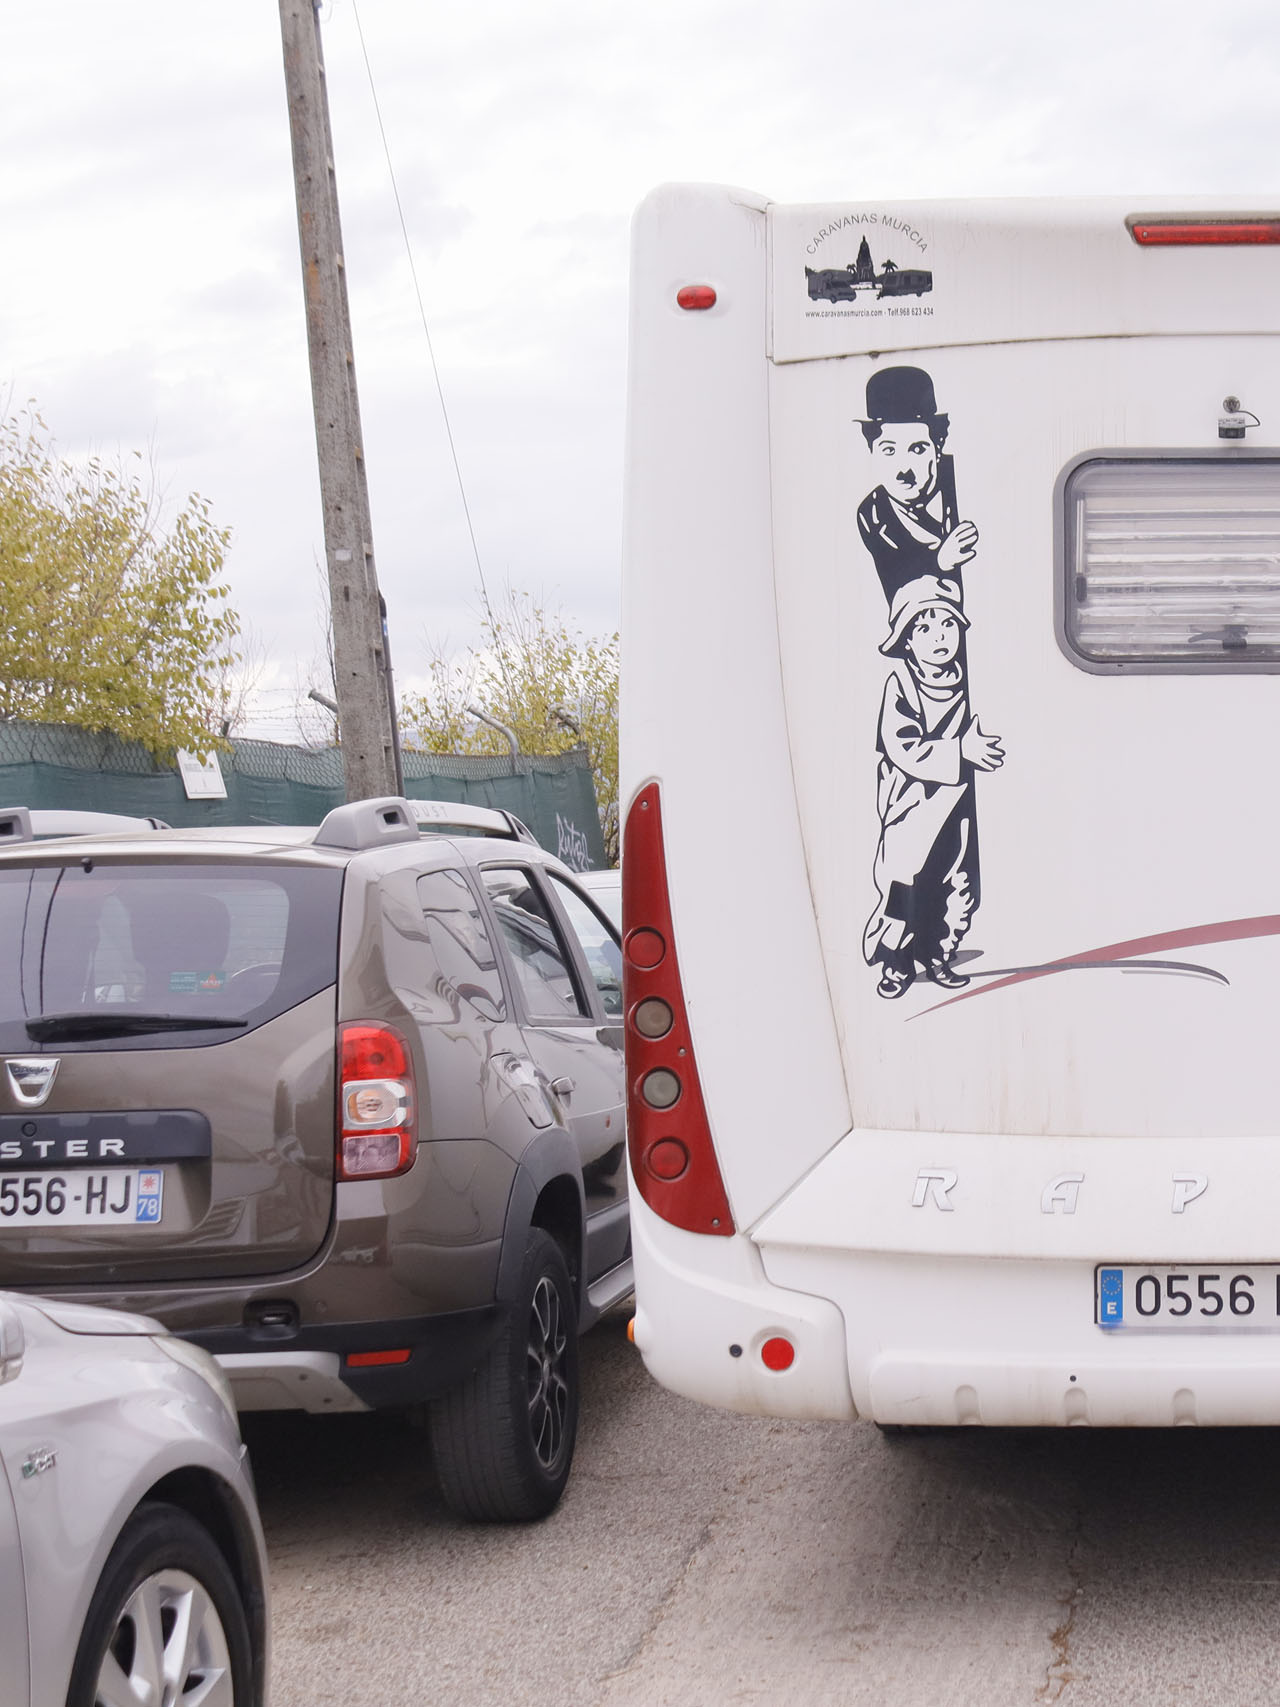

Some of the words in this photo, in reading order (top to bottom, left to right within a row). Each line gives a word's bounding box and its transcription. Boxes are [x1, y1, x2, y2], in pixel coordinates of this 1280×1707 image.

[806, 213, 878, 255] CARAVANAS
[881, 215, 928, 253] MURCIA
[138, 1198, 158, 1217] 78
[1107, 1302, 1117, 1314] E
[1135, 1274, 1255, 1317] 0556
